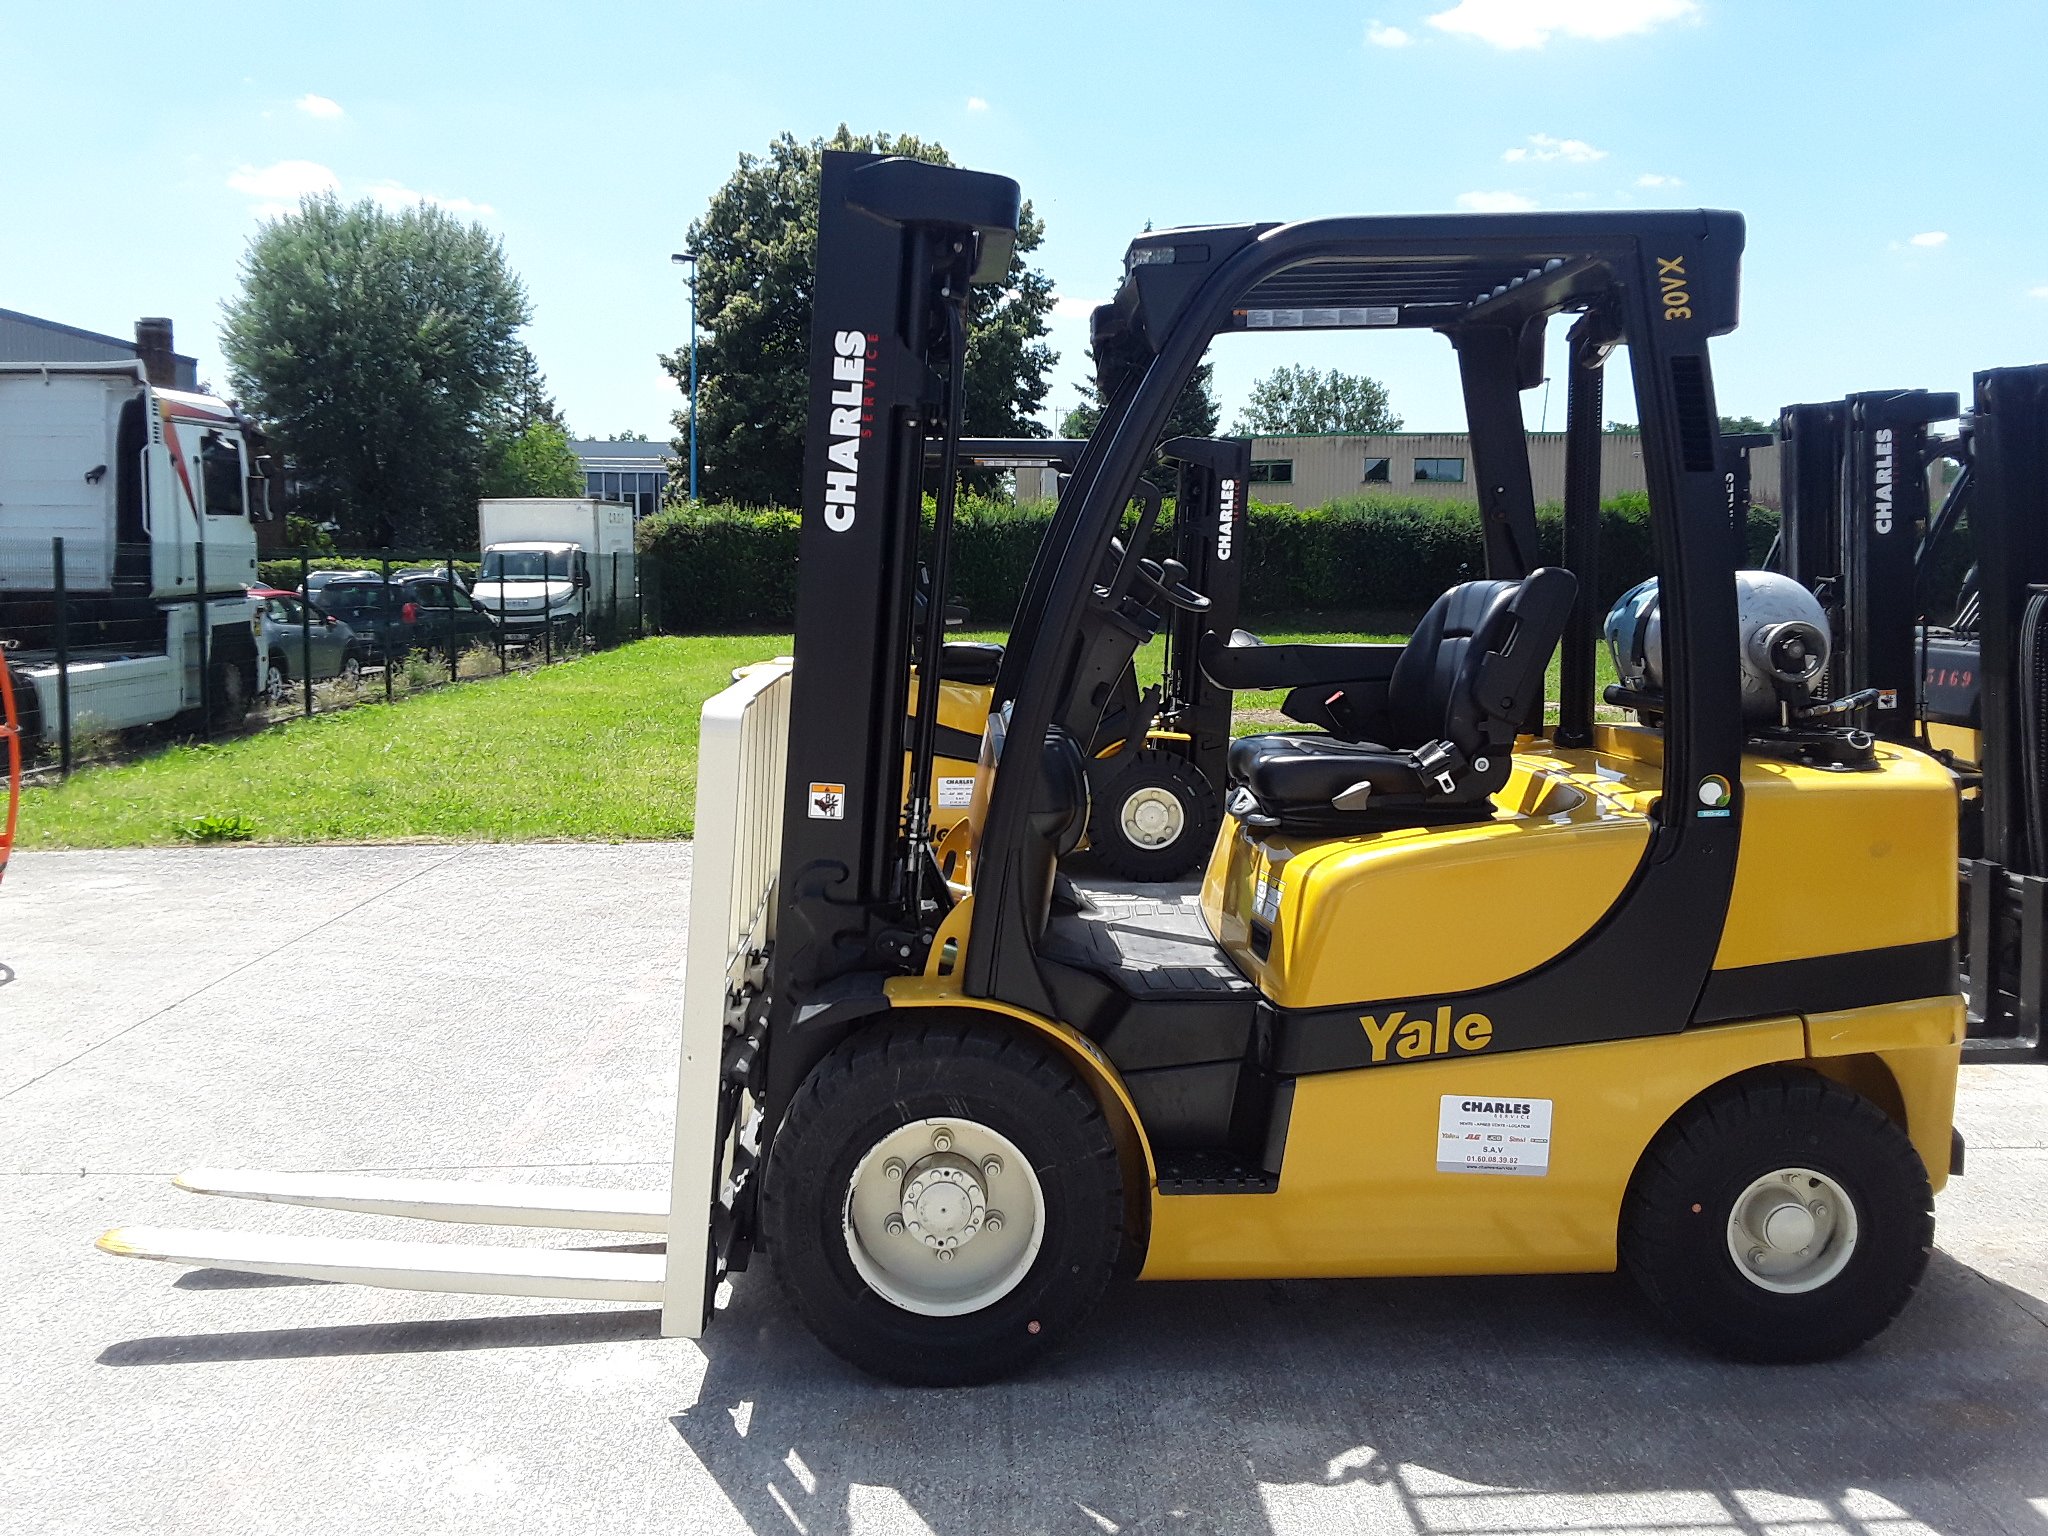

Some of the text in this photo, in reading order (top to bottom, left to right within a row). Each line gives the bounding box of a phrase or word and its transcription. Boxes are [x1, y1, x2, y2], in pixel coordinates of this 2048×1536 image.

[1657, 256, 1692, 320] 30VX
[861, 333, 879, 438] SERVICE
[824, 330, 866, 532] CHARLES
[1217, 479, 1235, 560] CHARLES
[1876, 428, 1893, 534] CHARLES
[1359, 1006, 1493, 1062] Yale
[1461, 1101, 1531, 1115] CHARLES
